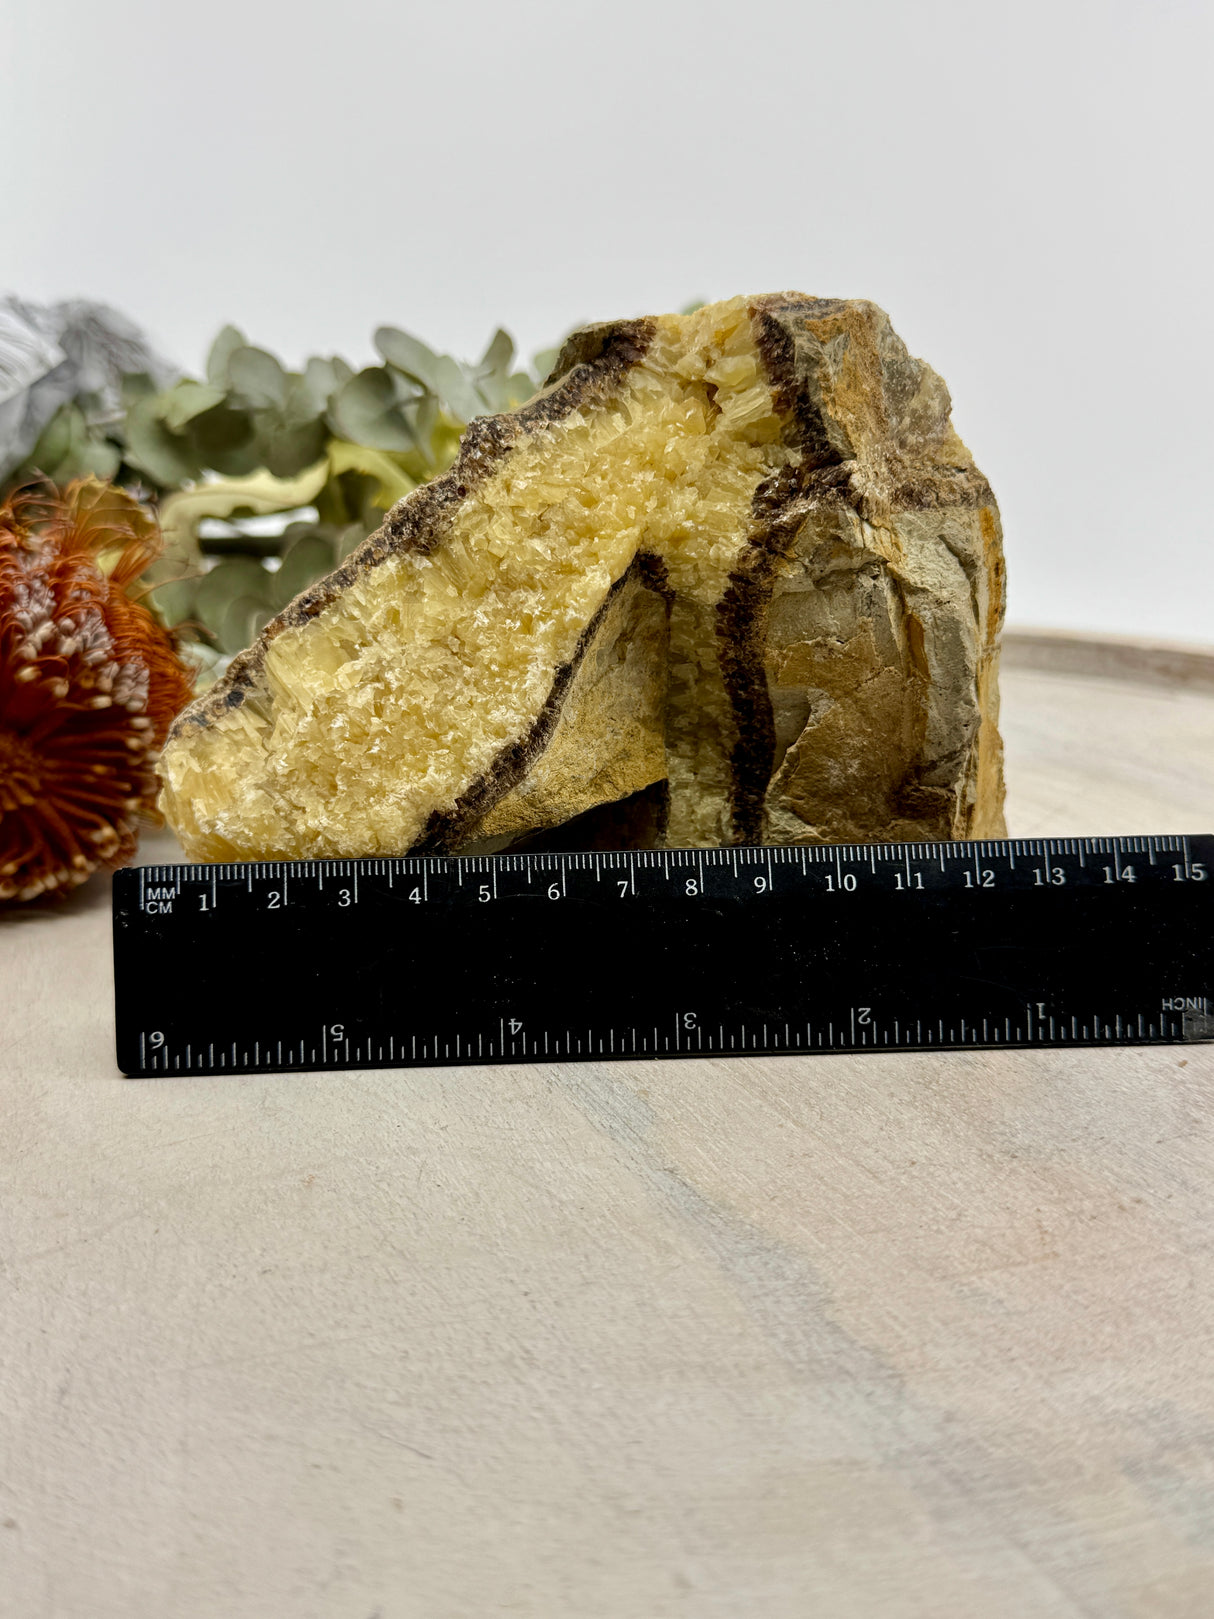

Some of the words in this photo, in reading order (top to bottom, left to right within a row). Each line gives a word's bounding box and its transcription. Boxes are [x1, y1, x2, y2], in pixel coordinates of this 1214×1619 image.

[147, 887, 175, 900] MM
[199, 894, 209, 911] 1
[267, 892, 281, 909] 2
[338, 890, 351, 906] 3
[409, 887, 421, 904] 4
[478, 885, 491, 902] 5
[548, 883, 560, 900] 6
[617, 881, 629, 898] 7
[685, 879, 698, 896] 8
[754, 877, 766, 893] 9
[825, 875, 857, 891] 10
[894, 872, 925, 890] 11
[964, 870, 996, 888] 12
[1033, 868, 1066, 886] 13
[1103, 866, 1137, 883] 14
[1173, 864, 1207, 882] 15
[146, 901, 172, 914] CM
[1036, 1003, 1046, 1019] 1
[1162, 997, 1202, 1010] INCH
[683, 1012, 697, 1029] 3
[858, 1008, 871, 1024] 2
[330, 1024, 344, 1041] 5
[509, 1018, 522, 1034] 4
[150, 1031, 165, 1048] 6
